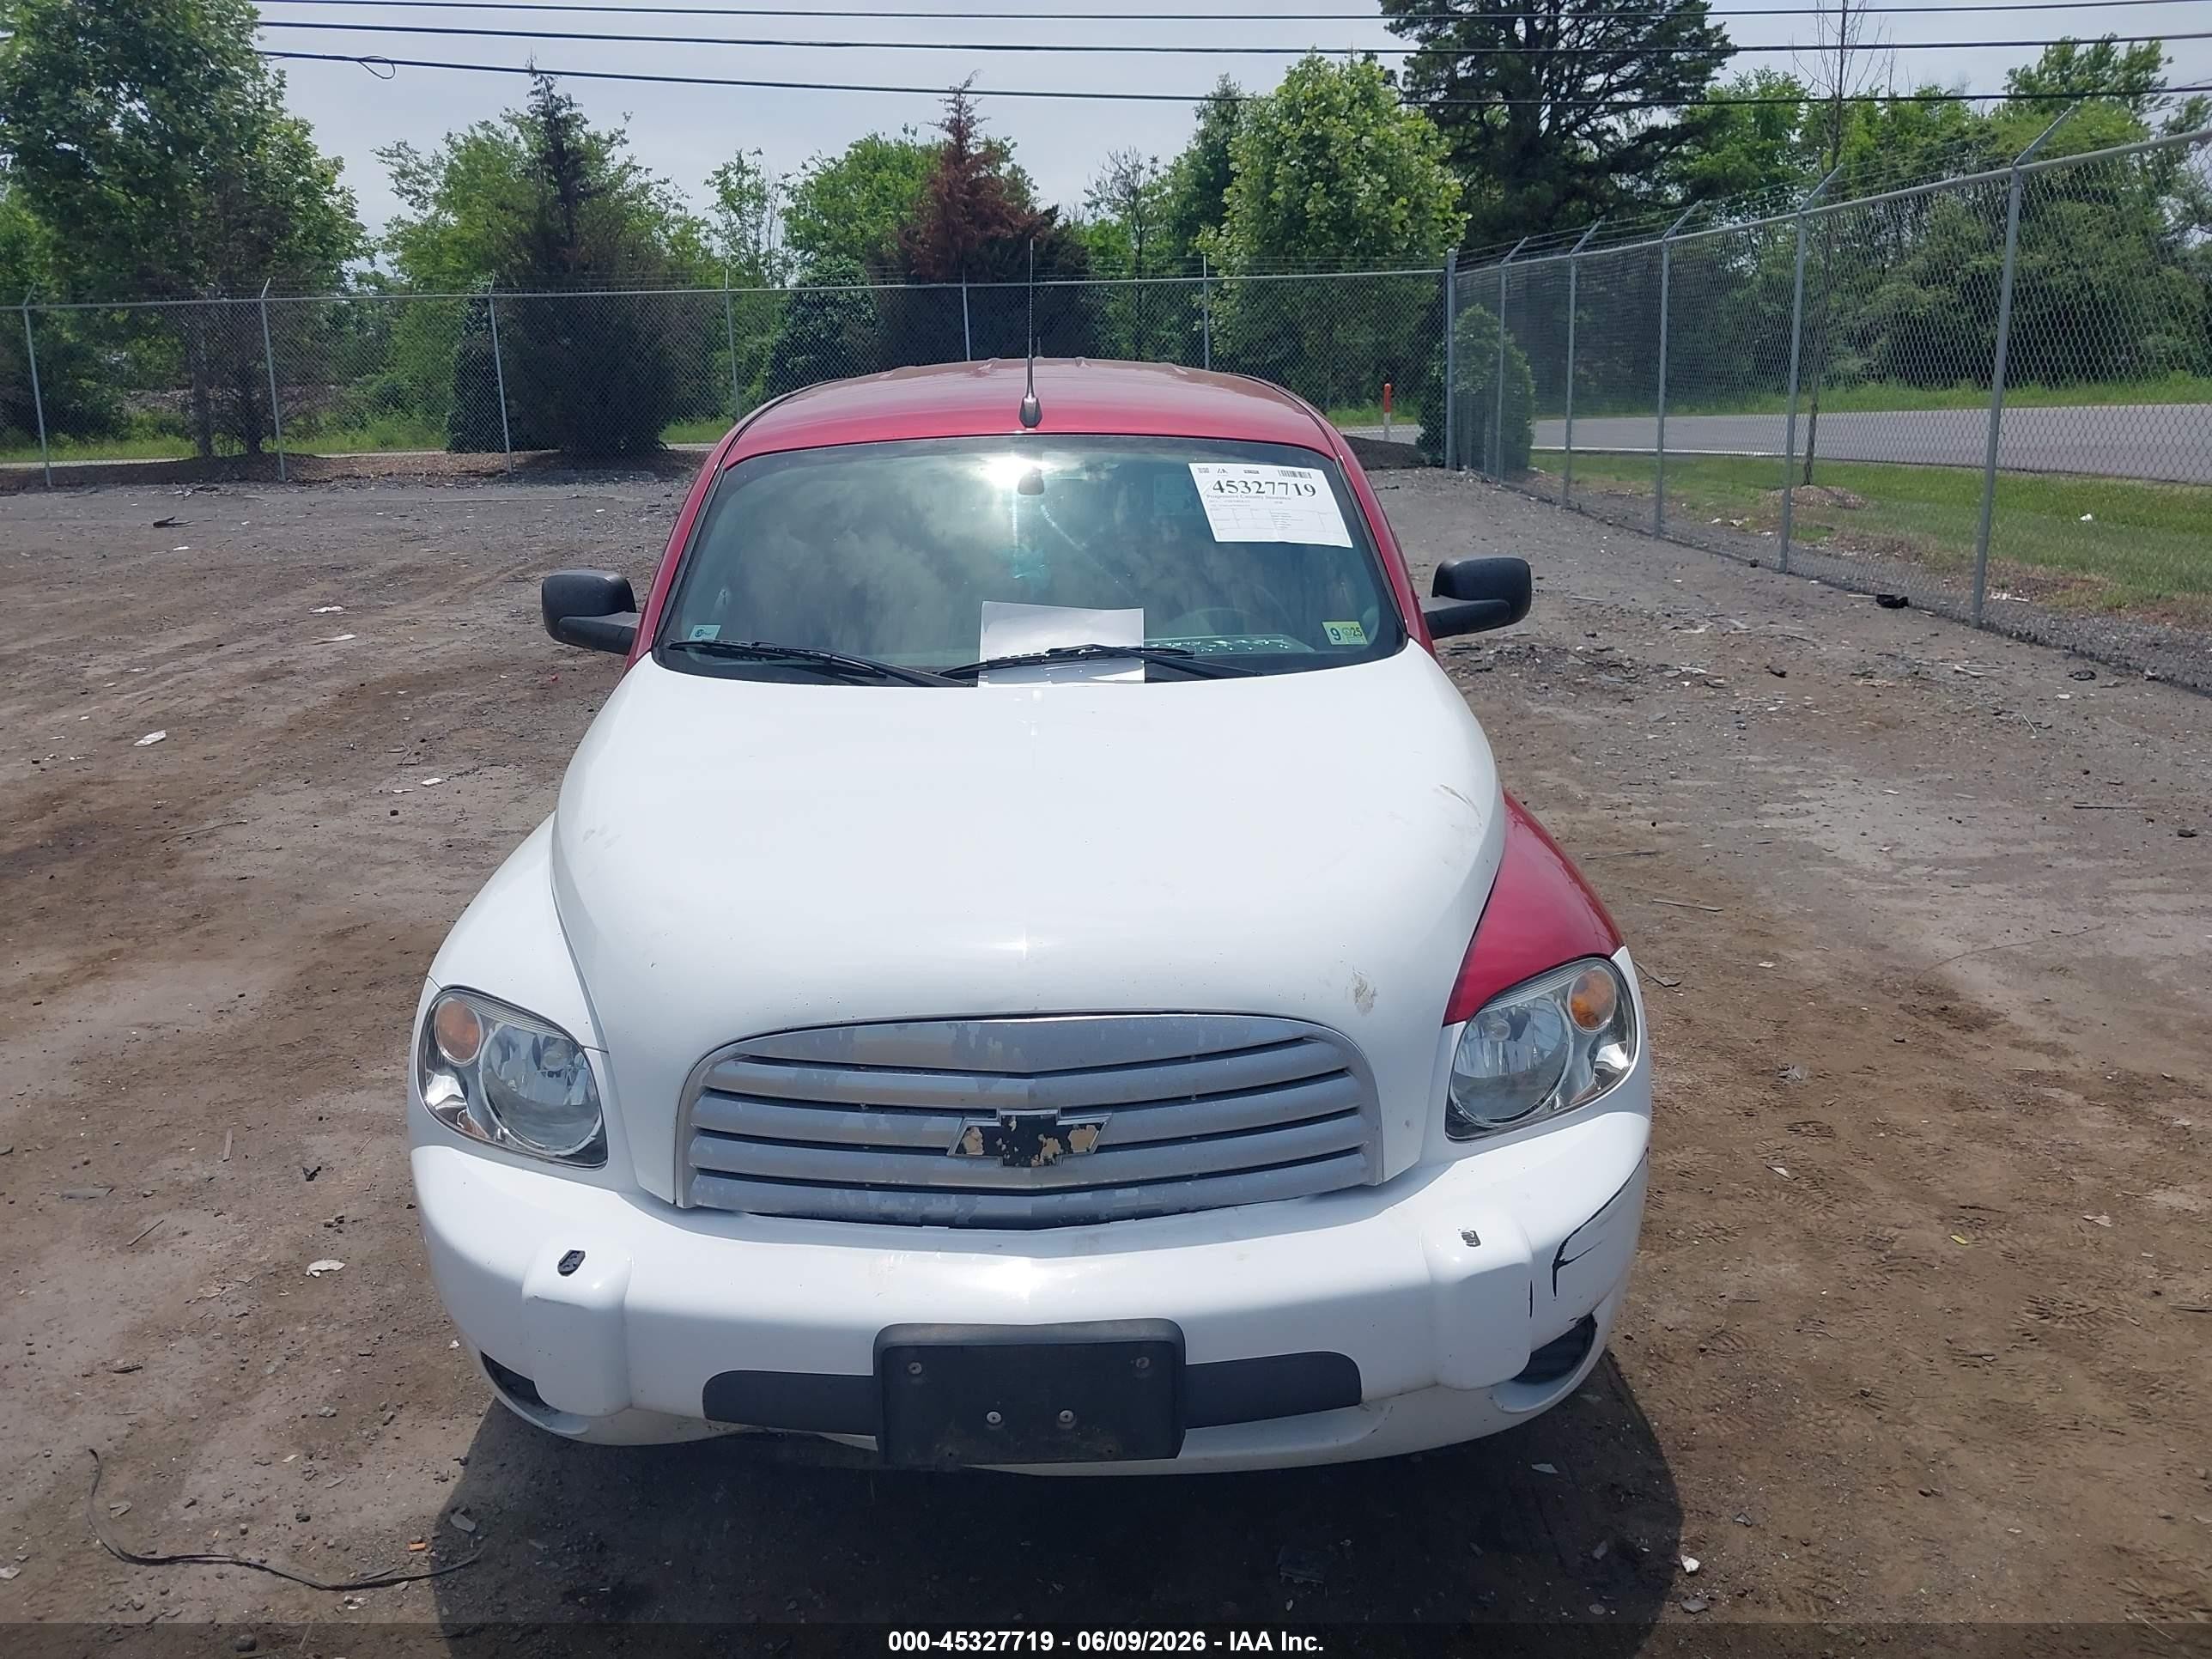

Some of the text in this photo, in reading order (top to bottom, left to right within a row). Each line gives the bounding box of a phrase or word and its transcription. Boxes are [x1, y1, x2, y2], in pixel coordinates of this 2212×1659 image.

[1212, 480, 1316, 497] 45327719
[1330, 627, 1363, 641] 9 25
